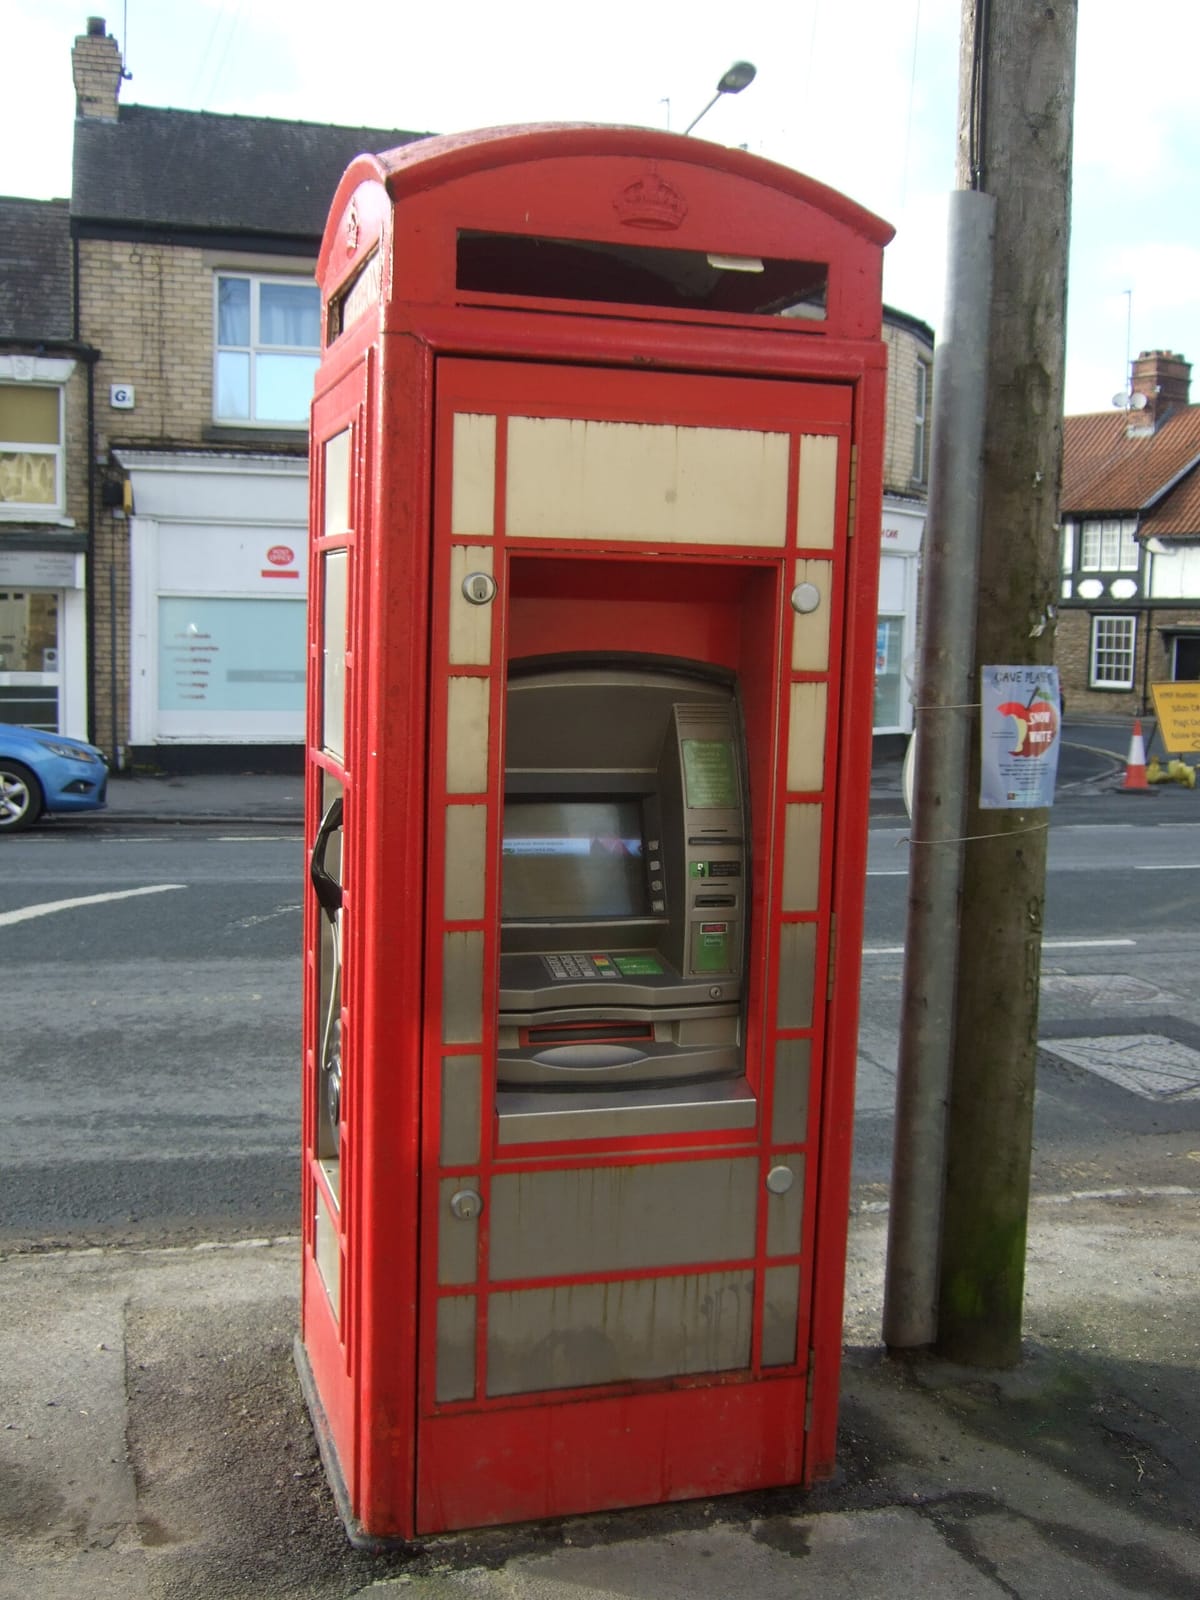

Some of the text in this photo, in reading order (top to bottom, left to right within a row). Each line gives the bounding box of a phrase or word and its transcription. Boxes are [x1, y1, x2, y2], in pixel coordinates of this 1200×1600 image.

[269, 554, 291, 562] OFFICE
[1027, 711, 1051, 725] SNOW
[1028, 730, 1053, 743] WHITE
